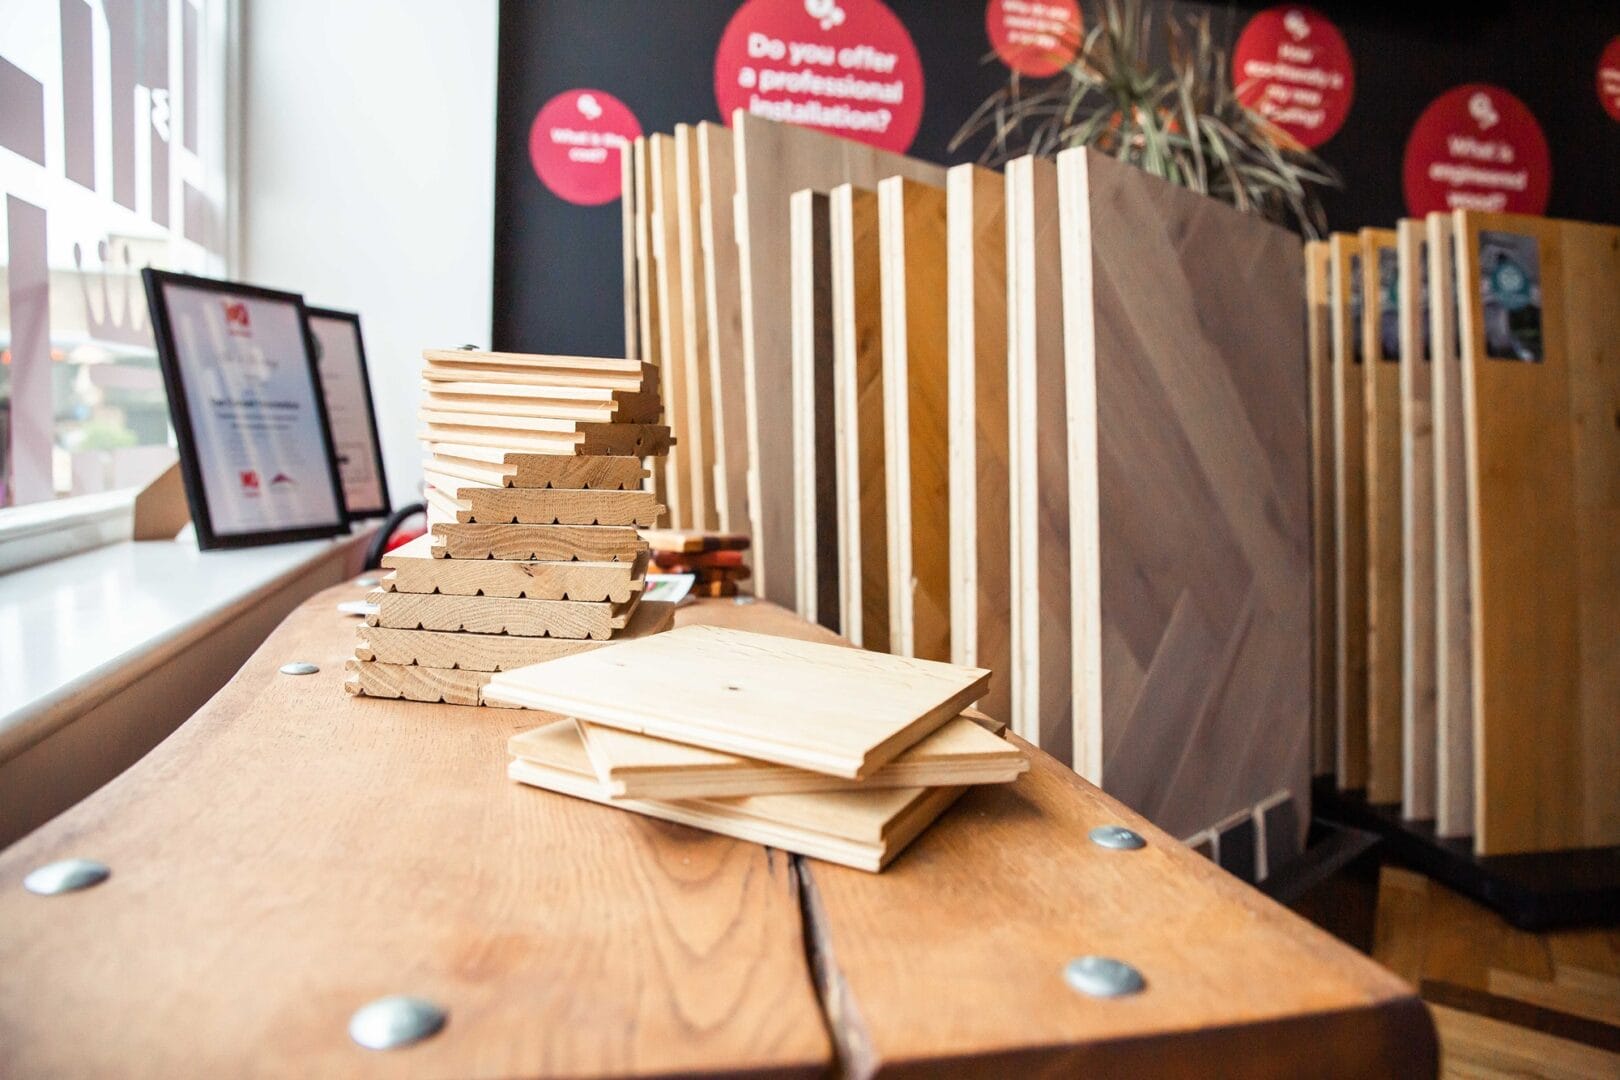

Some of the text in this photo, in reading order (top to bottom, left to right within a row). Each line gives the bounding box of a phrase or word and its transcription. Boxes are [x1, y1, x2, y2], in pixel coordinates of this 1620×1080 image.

[747, 32, 898, 73] Do you offer
[737, 66, 904, 104] a professional
